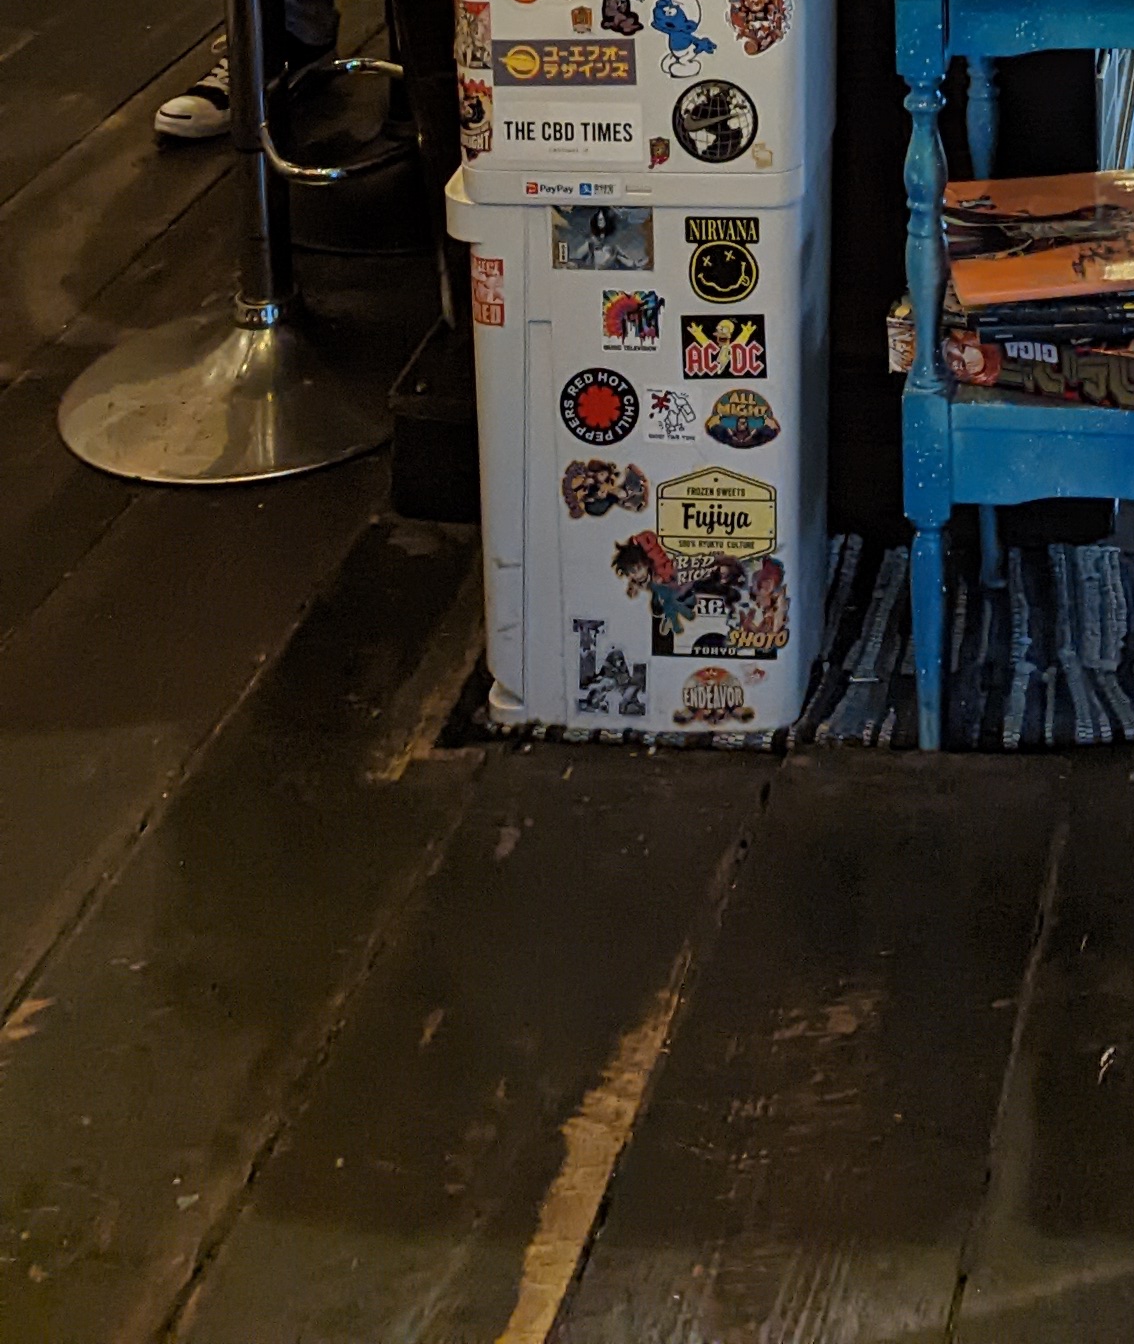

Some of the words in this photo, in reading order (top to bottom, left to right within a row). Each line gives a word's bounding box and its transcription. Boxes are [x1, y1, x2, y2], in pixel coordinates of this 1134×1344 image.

[504, 120, 537, 141] THE
[541, 121, 575, 142] CBD
[580, 122, 633, 143] TIMES
[539, 184, 574, 195] PayPay
[688, 218, 759, 242] NIRVANA
[1004, 341, 1058, 364] GIGA
[567, 373, 594, 397] RED
[598, 371, 628, 393] HOT
[729, 392, 756, 406] ALL
[563, 398, 614, 442] PEPPERS
[615, 395, 635, 436] CHILI
[686, 486, 714, 497] FROZEN
[682, 502, 752, 535] Fujiya
[675, 554, 715, 569] RED
[728, 628, 789, 649] SHOTO
[682, 685, 745, 709] ENDEAVOR
